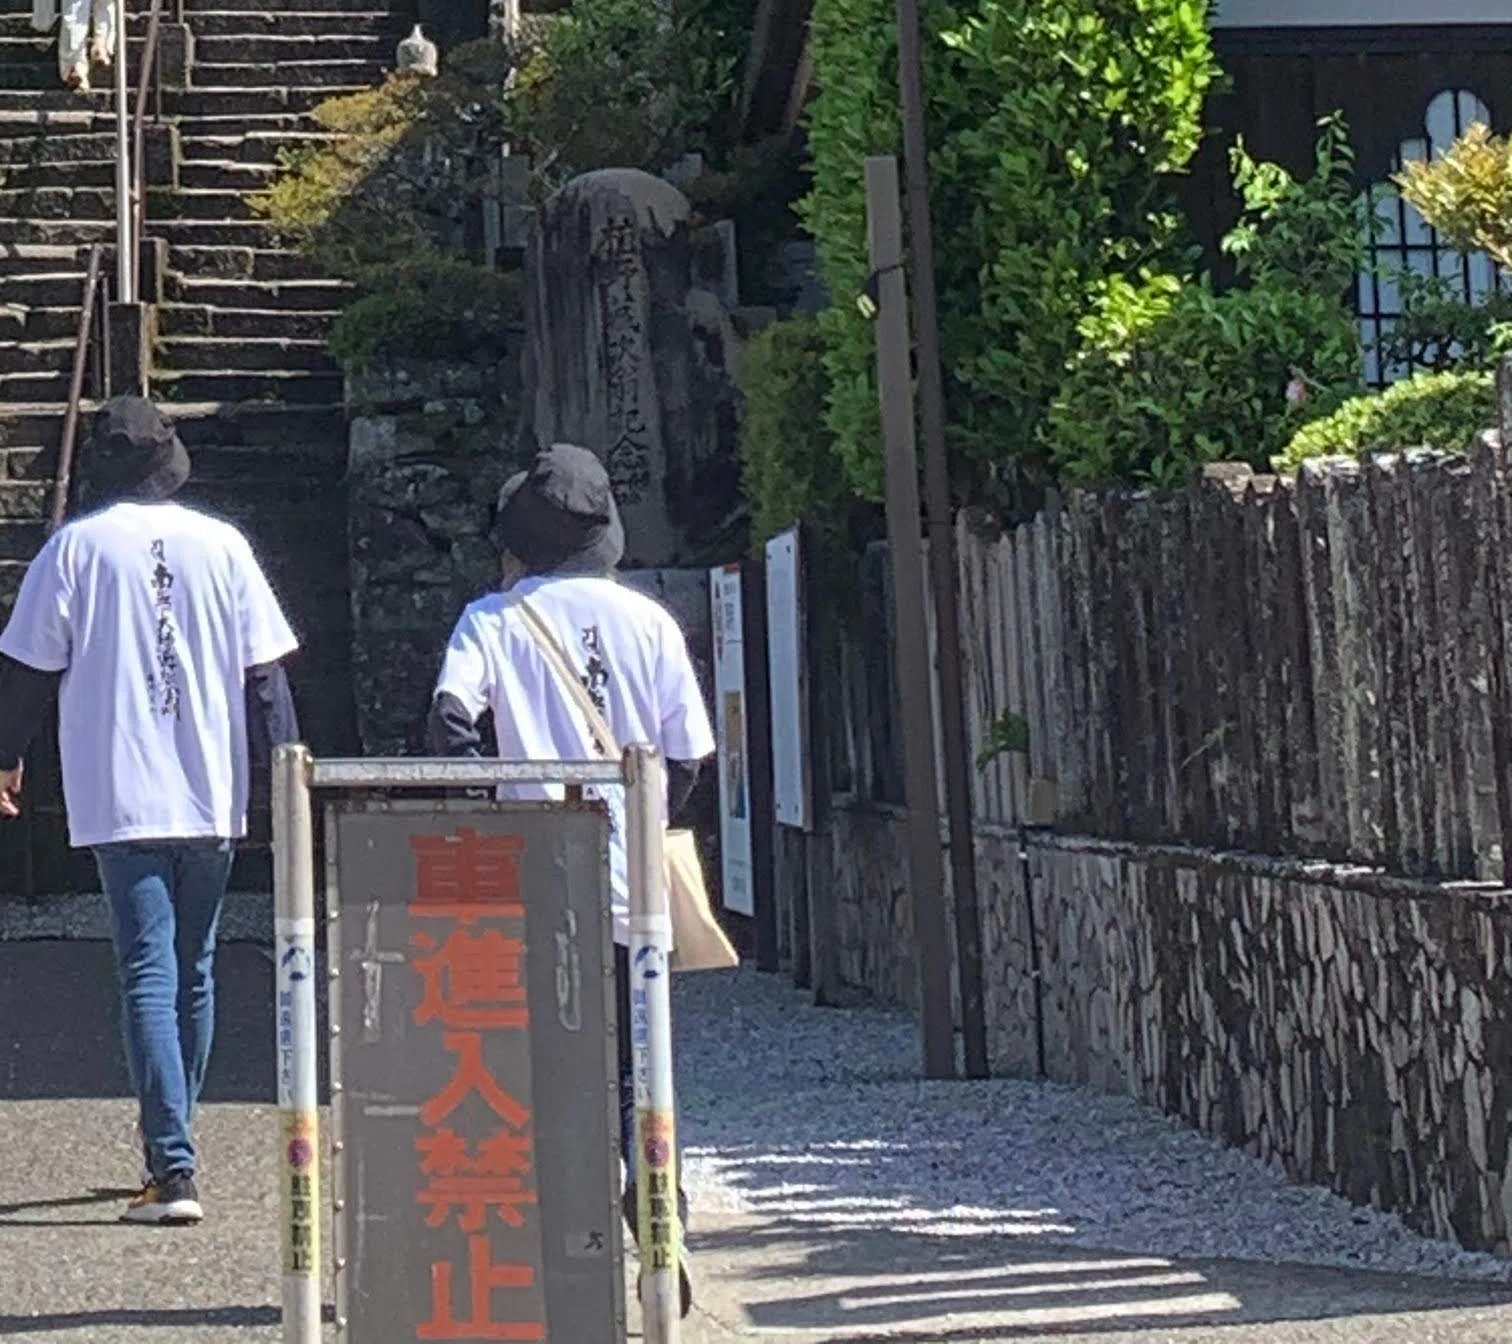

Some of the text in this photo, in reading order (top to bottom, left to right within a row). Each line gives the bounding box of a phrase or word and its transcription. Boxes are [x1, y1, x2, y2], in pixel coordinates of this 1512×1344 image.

[407, 827, 546, 1341] 車進入禁止
